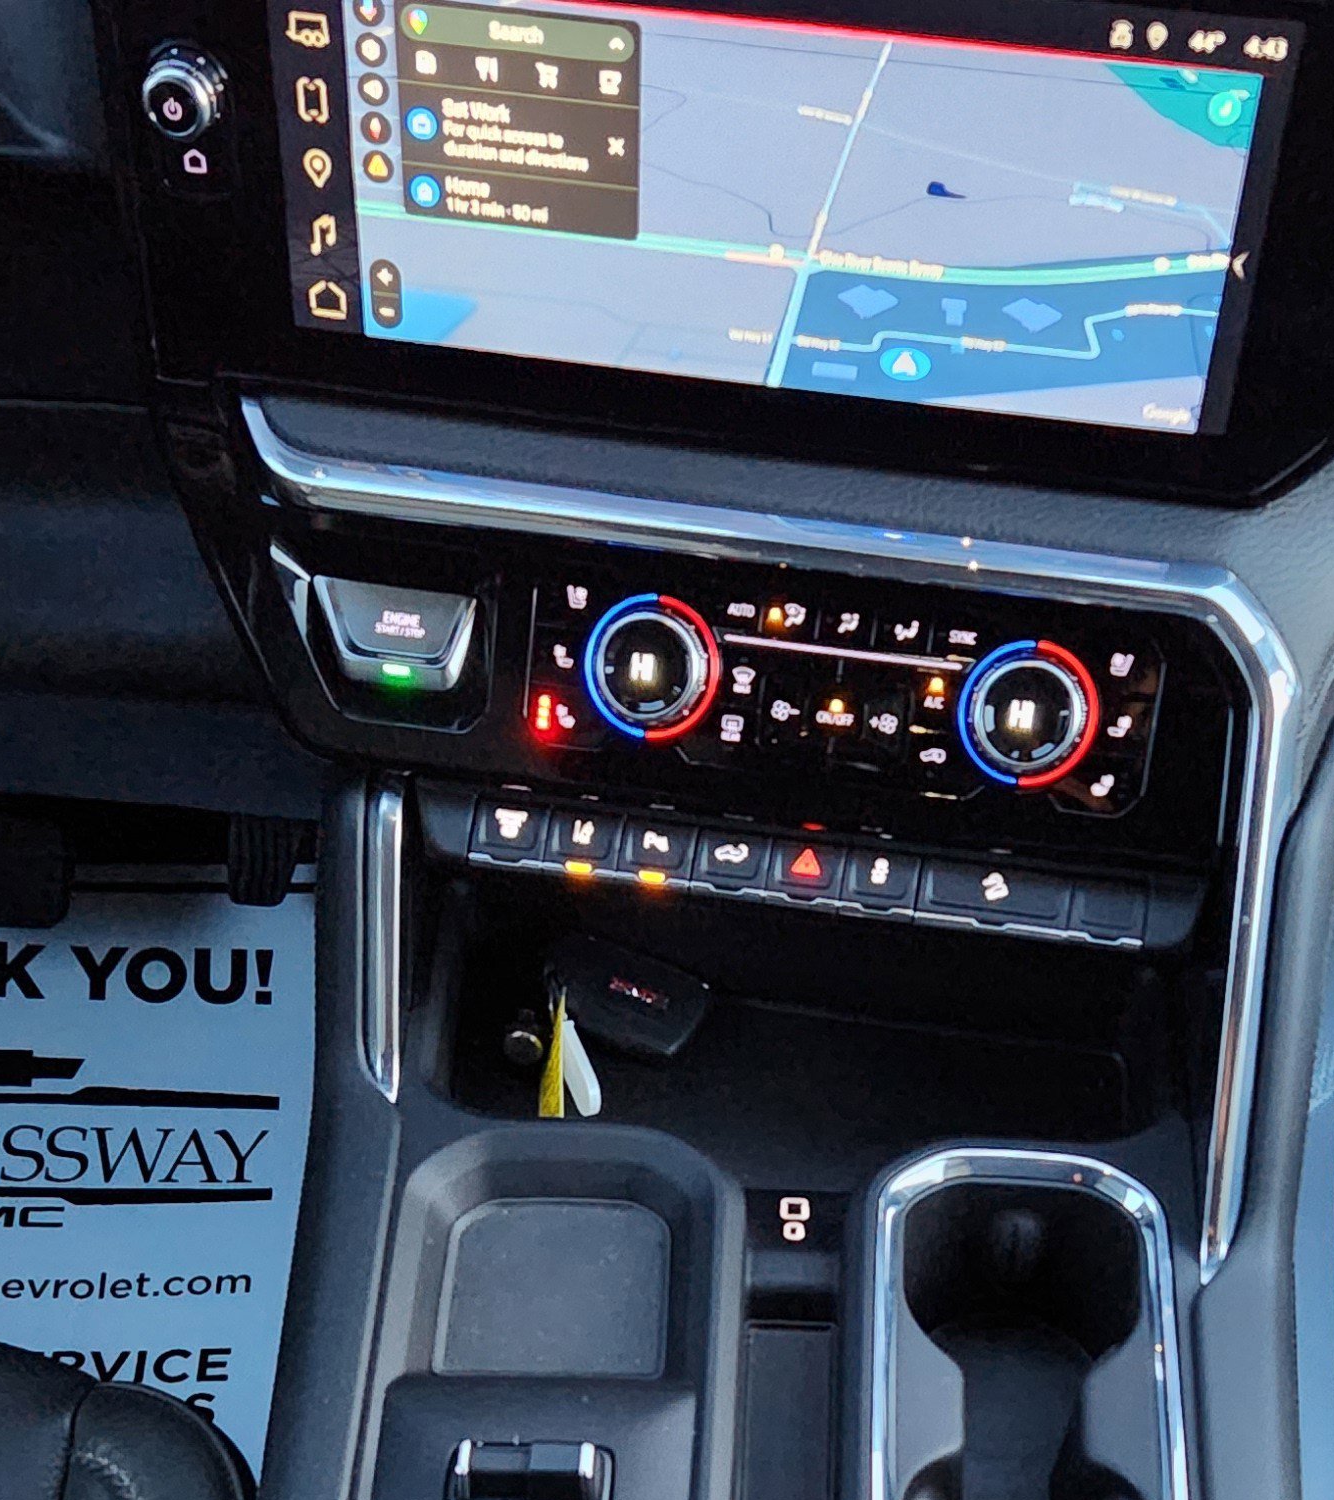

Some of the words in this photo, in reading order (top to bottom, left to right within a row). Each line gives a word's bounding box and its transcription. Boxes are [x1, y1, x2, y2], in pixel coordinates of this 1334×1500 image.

[488, 19, 545, 45] Search
[442, 98, 469, 119] Set
[469, 101, 510, 123] Work
[499, 147, 524, 164] and
[445, 175, 490, 198] Home
[382, 610, 421, 628] ENGINE
[727, 602, 756, 618] AUTO
[948, 629, 978, 645] SYNC
[71, 946, 274, 1005] YOU!
[33, 1347, 232, 1384] RVICE
